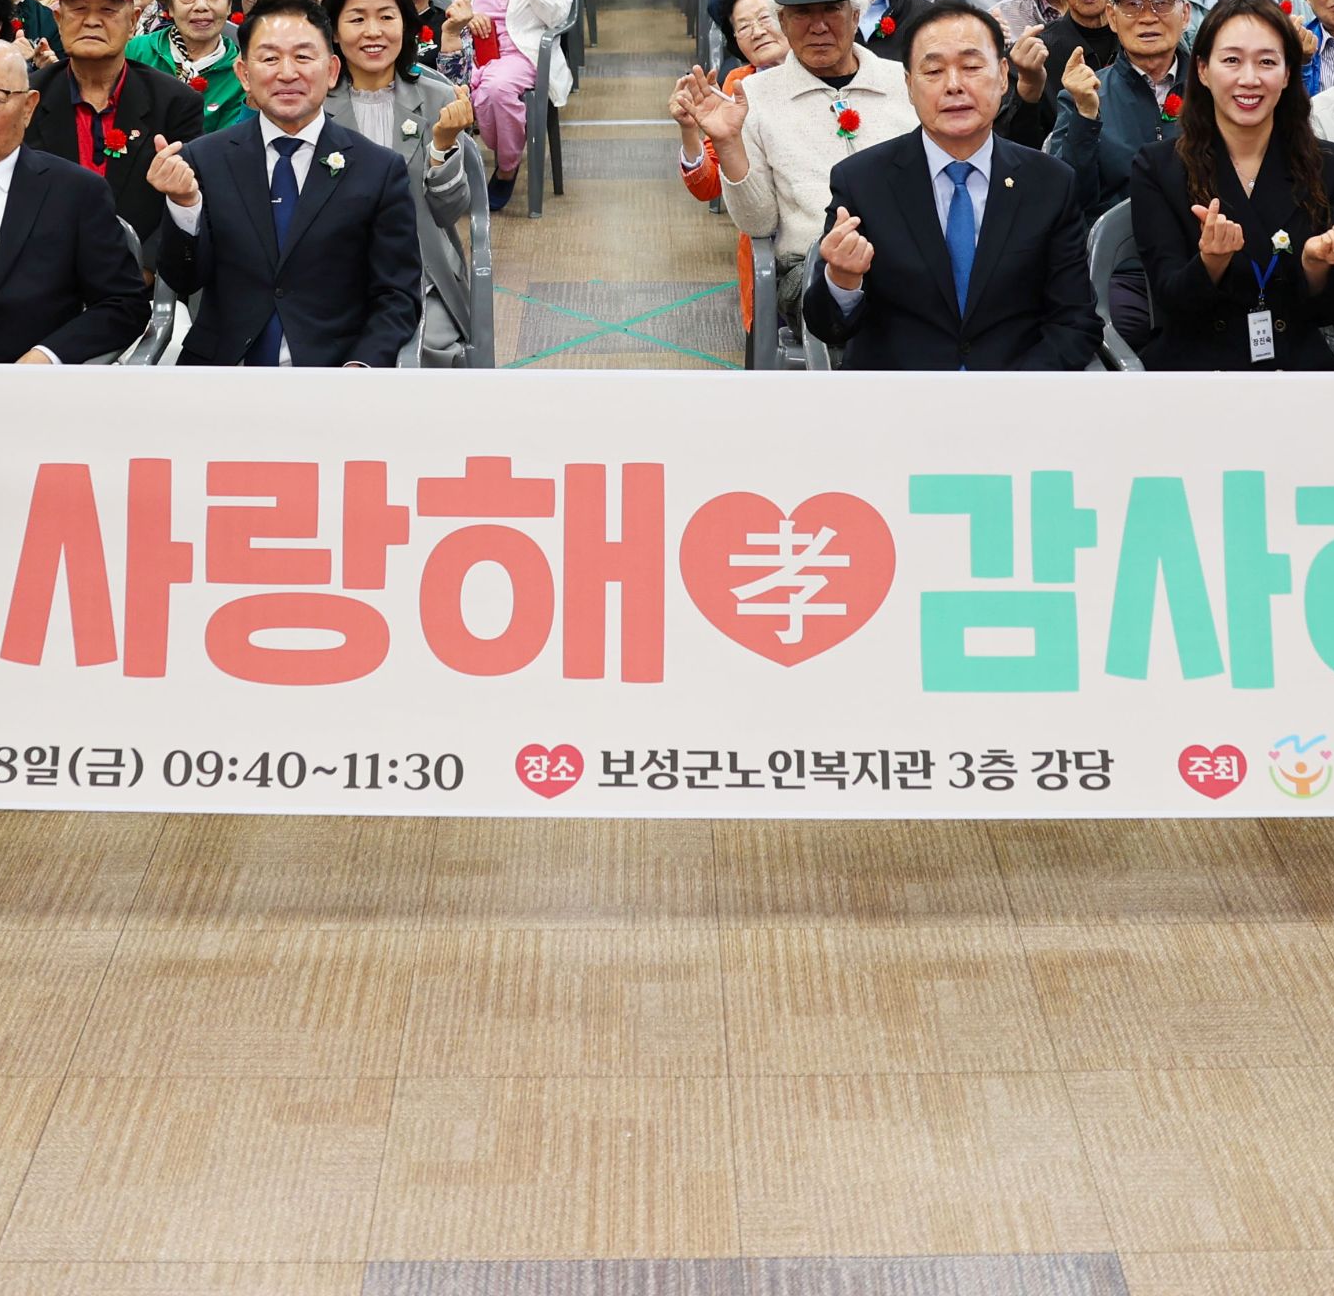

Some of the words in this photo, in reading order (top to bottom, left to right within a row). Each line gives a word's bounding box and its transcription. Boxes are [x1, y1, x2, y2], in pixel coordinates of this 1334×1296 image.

[0, 455, 666, 687] 사랑해
[728, 518, 852, 645] 孝
[162, 749, 465, 791] 09:40~11:30
[522, 753, 577, 784] 장소
[598, 748, 937, 790] 보성군노인복지관
[948, 749, 1018, 791] 3층
[1031, 749, 1115, 791] 강당
[1186, 755, 1240, 783] 주최
